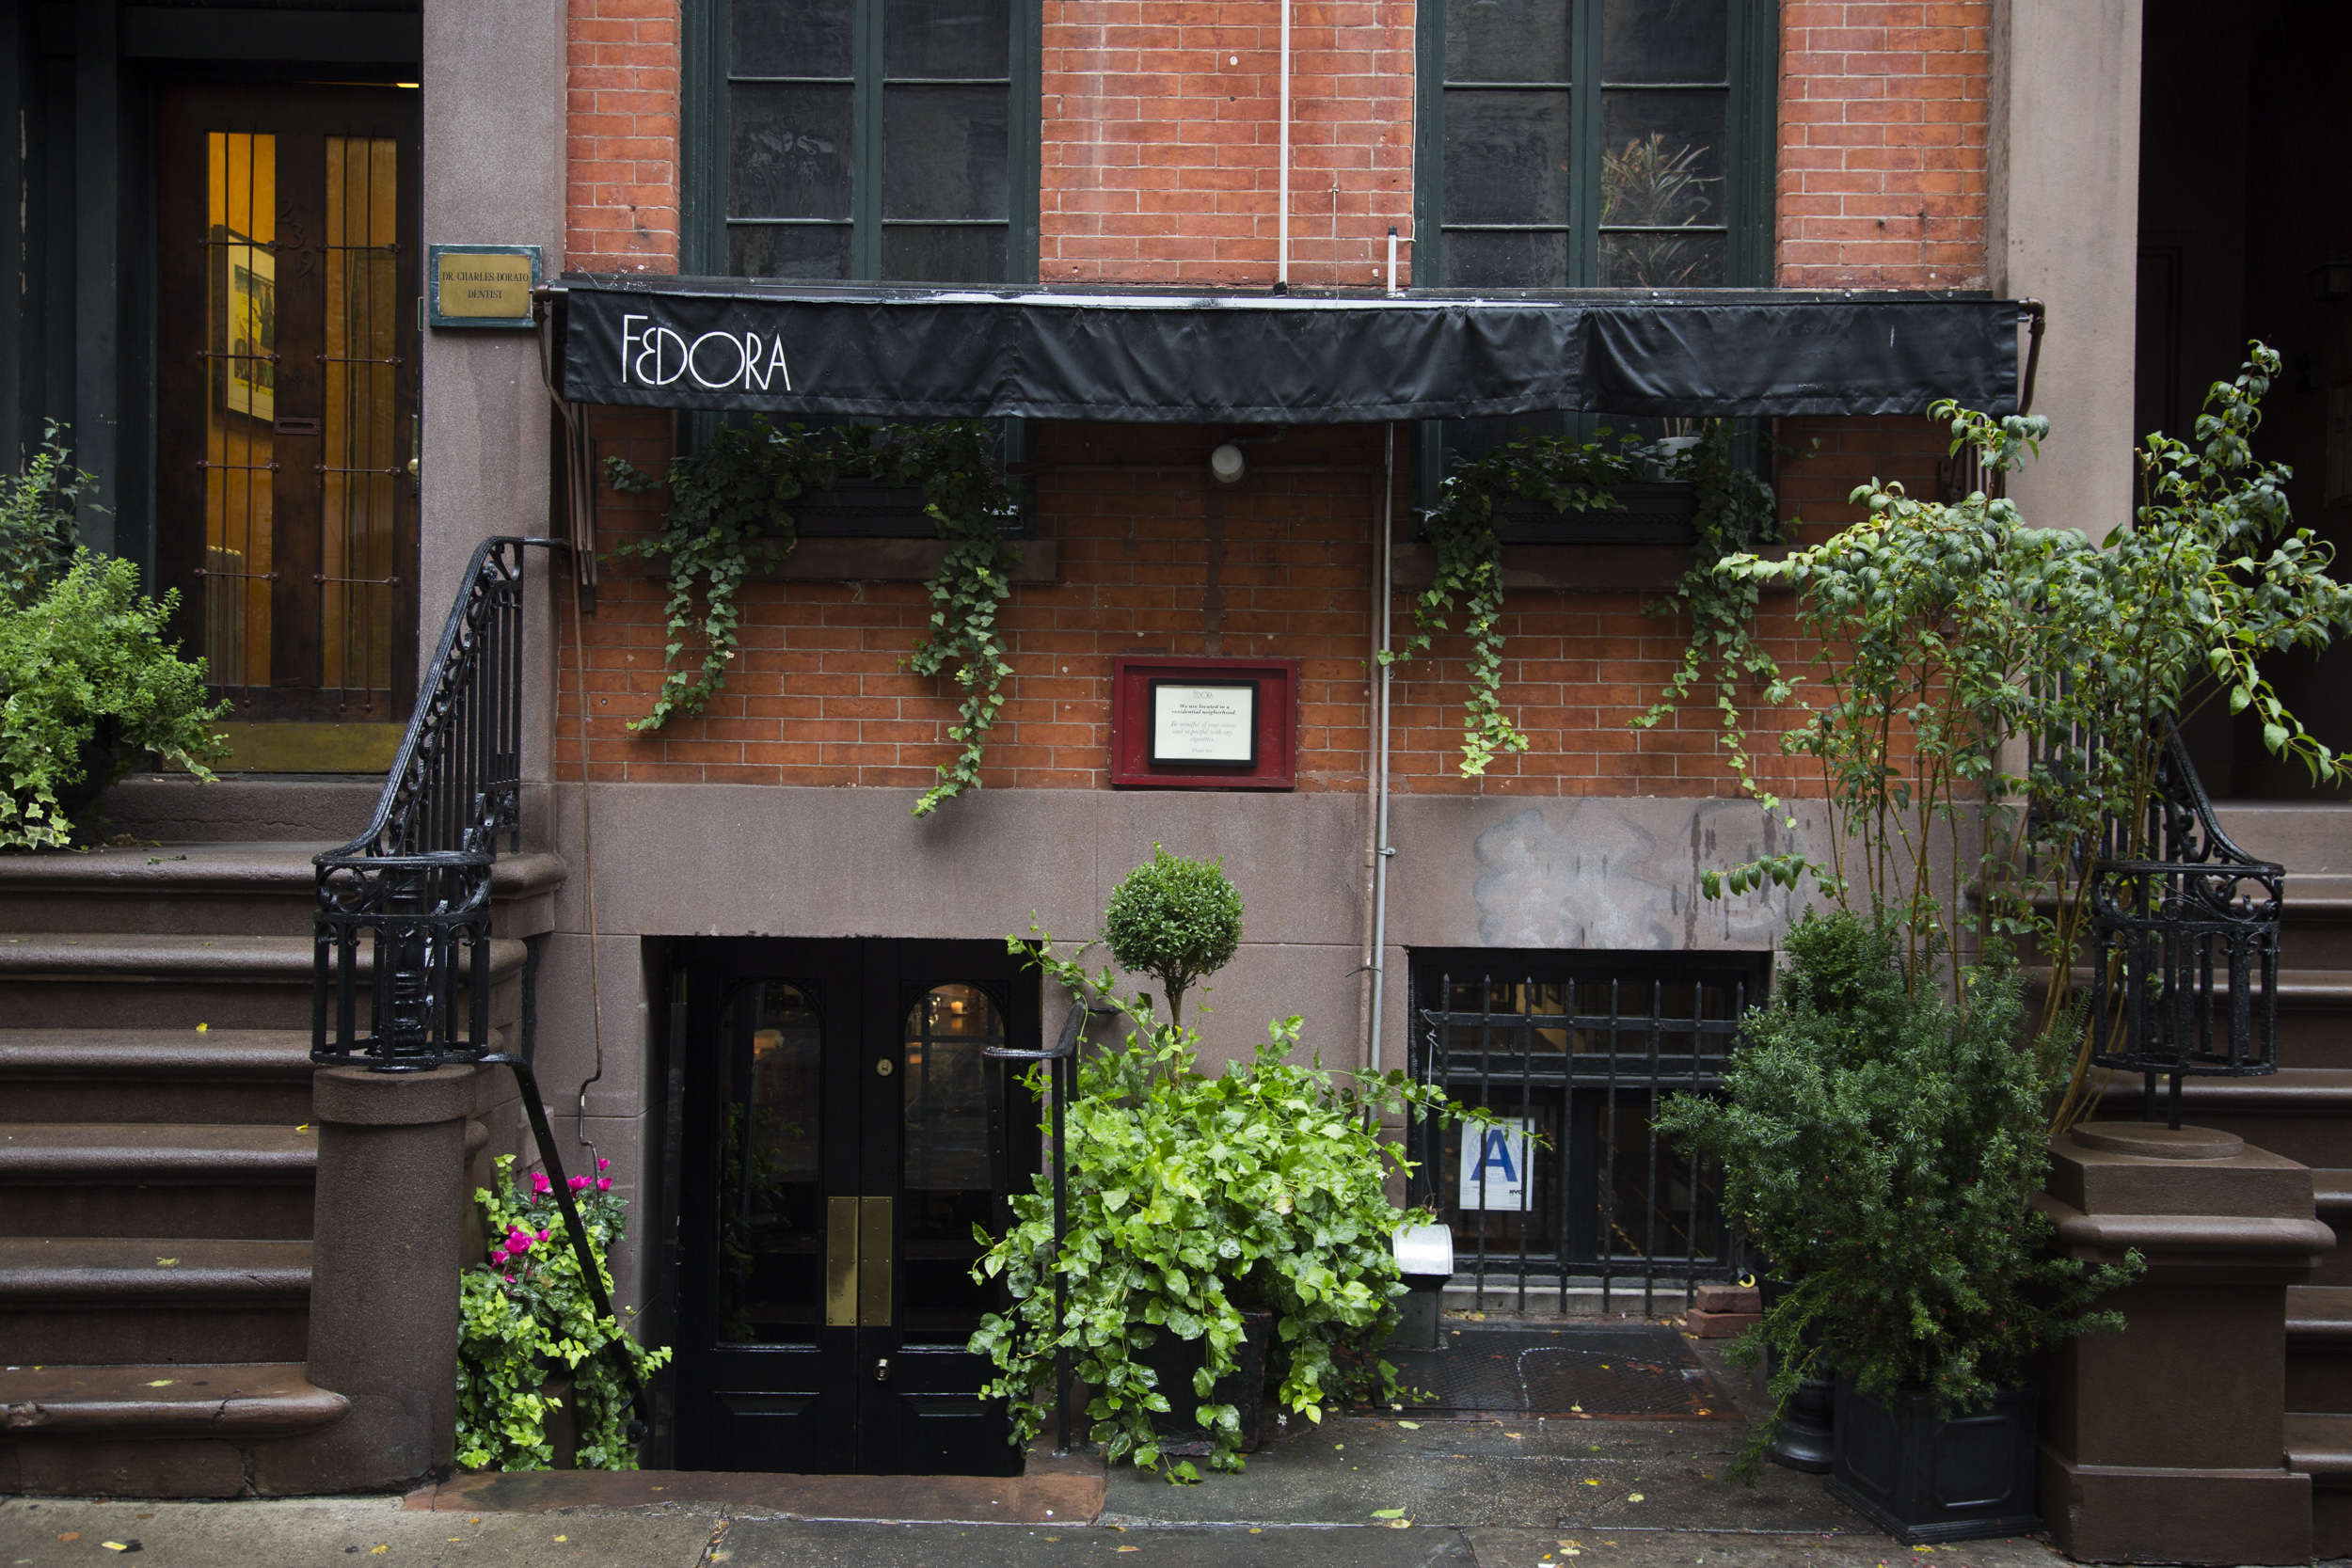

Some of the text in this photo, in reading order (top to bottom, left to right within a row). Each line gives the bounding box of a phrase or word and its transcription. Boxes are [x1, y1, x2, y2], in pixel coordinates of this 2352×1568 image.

[276, 198, 315, 278] 239
[456, 272, 494, 281] CHARLES
[497, 273, 529, 282] DORATO
[468, 290, 502, 299] DENTIST
[622, 314, 791, 391] FEDORA
[1470, 1130, 1518, 1182] A
